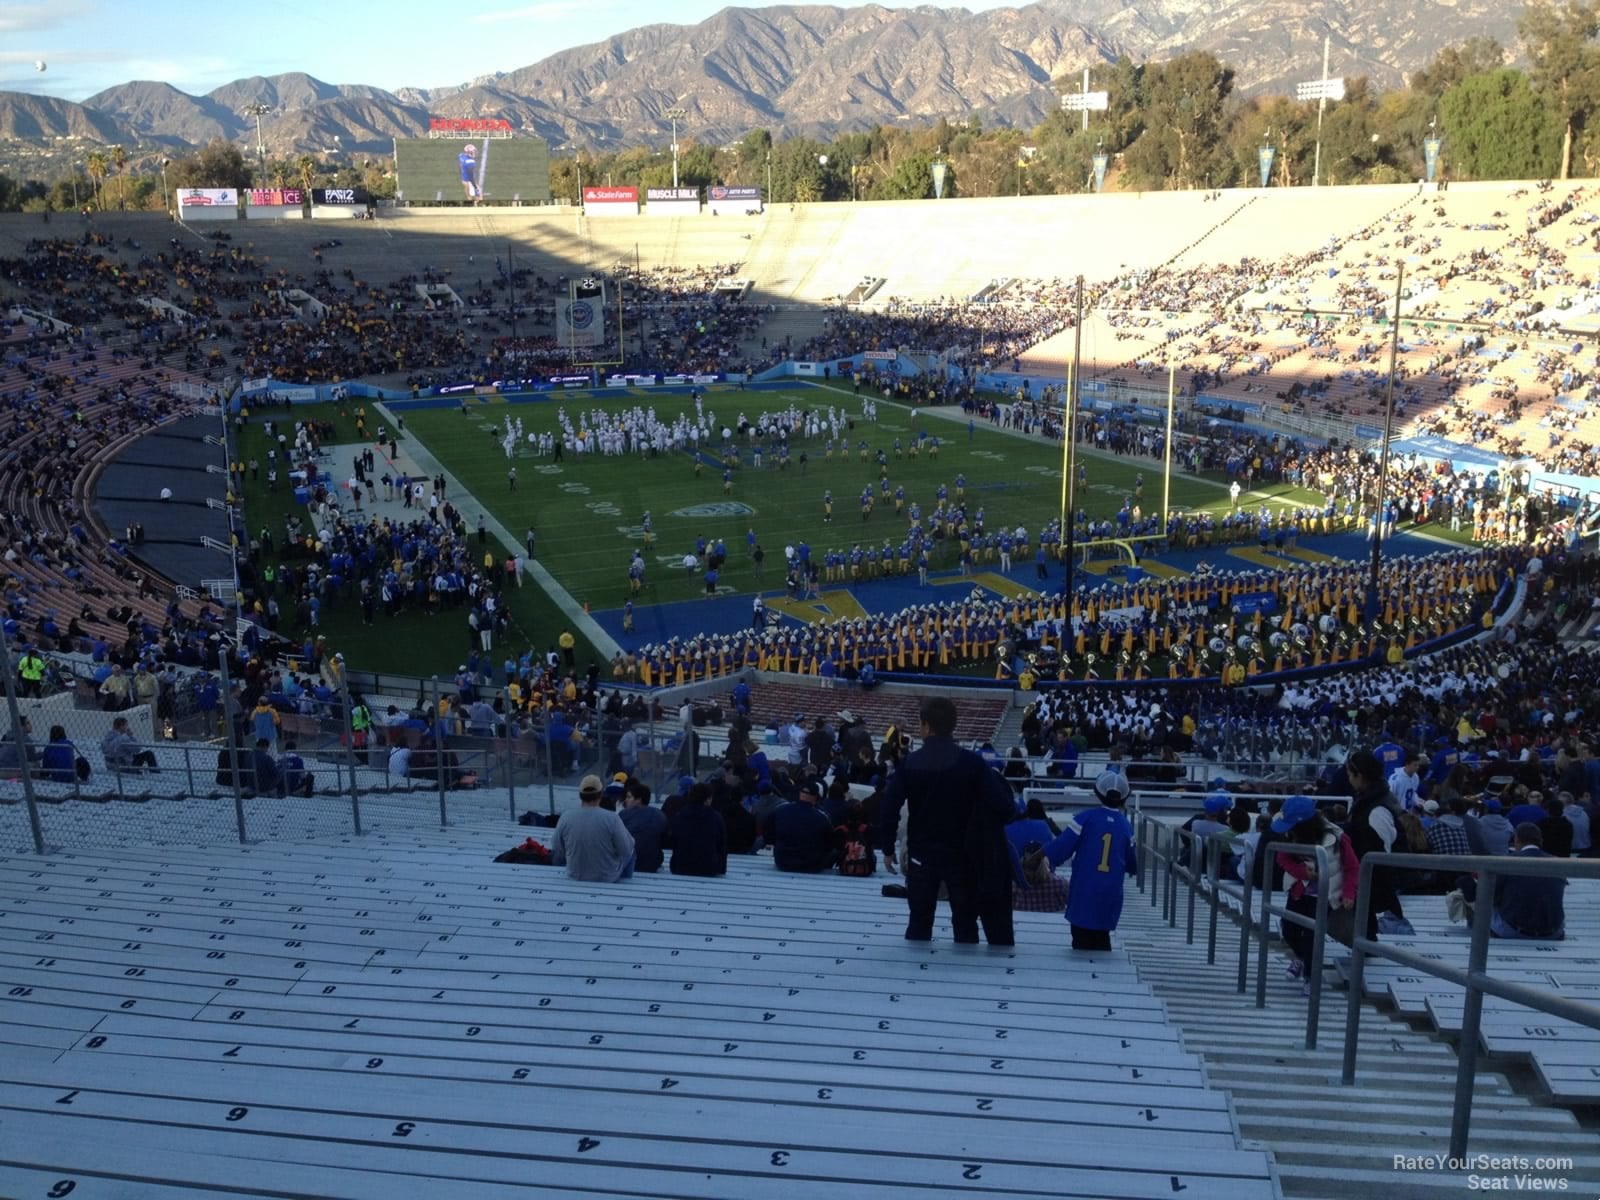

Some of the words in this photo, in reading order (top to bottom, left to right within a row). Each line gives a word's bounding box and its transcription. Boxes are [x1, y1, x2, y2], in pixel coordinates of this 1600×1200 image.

[429, 118, 512, 131] HONDA
[284, 193, 301, 203] ICE
[647, 189, 677, 199] MUSCLE
[678, 189, 698, 199] MILK
[583, 279, 595, 289] 25
[1096, 832, 1112, 873] 1
[124, 968, 146, 976] 10
[224, 978, 238, 986] 9
[8, 987, 33, 996] 10
[322, 986, 336, 994] 8
[432, 990, 445, 998] 7
[788, 988, 799, 996] 4
[538, 998, 551, 1006] 6
[890, 994, 900, 1002] 3
[120, 1000, 136, 1008] 9
[648, 1004, 660, 1012] 5
[229, 1011, 245, 1020] 8
[763, 1012, 776, 1021] 4
[344, 1019, 360, 1028] 7
[878, 1021, 890, 1029] 3
[466, 1027, 480, 1036] 6
[996, 1030, 1008, 1038] 2
[1523, 1028, 1558, 1036] 101
[86, 1036, 107, 1048] 8
[588, 1035, 604, 1044] 5
[1121, 1040, 1131, 1048] 1
[223, 1046, 242, 1056] 7
[724, 1043, 738, 1052] 4
[854, 1050, 866, 1060] 3
[366, 1058, 383, 1068] 6
[990, 1060, 1004, 1069] 2
[512, 1069, 530, 1078] 5
[1132, 1070, 1143, 1078] 1
[660, 1078, 679, 1088] 4
[56, 1090, 80, 1104] 7
[818, 1088, 832, 1099] 3
[976, 1099, 993, 1110] 2
[226, 1107, 248, 1121] 6
[1146, 1110, 1158, 1120] 1
[392, 1123, 416, 1136] 5
[577, 1138, 600, 1152] 4
[771, 1152, 790, 1166] 3
[962, 1165, 982, 1179] 2
[1170, 1176, 1187, 1192] 1
[47, 1180, 76, 1198] 6
